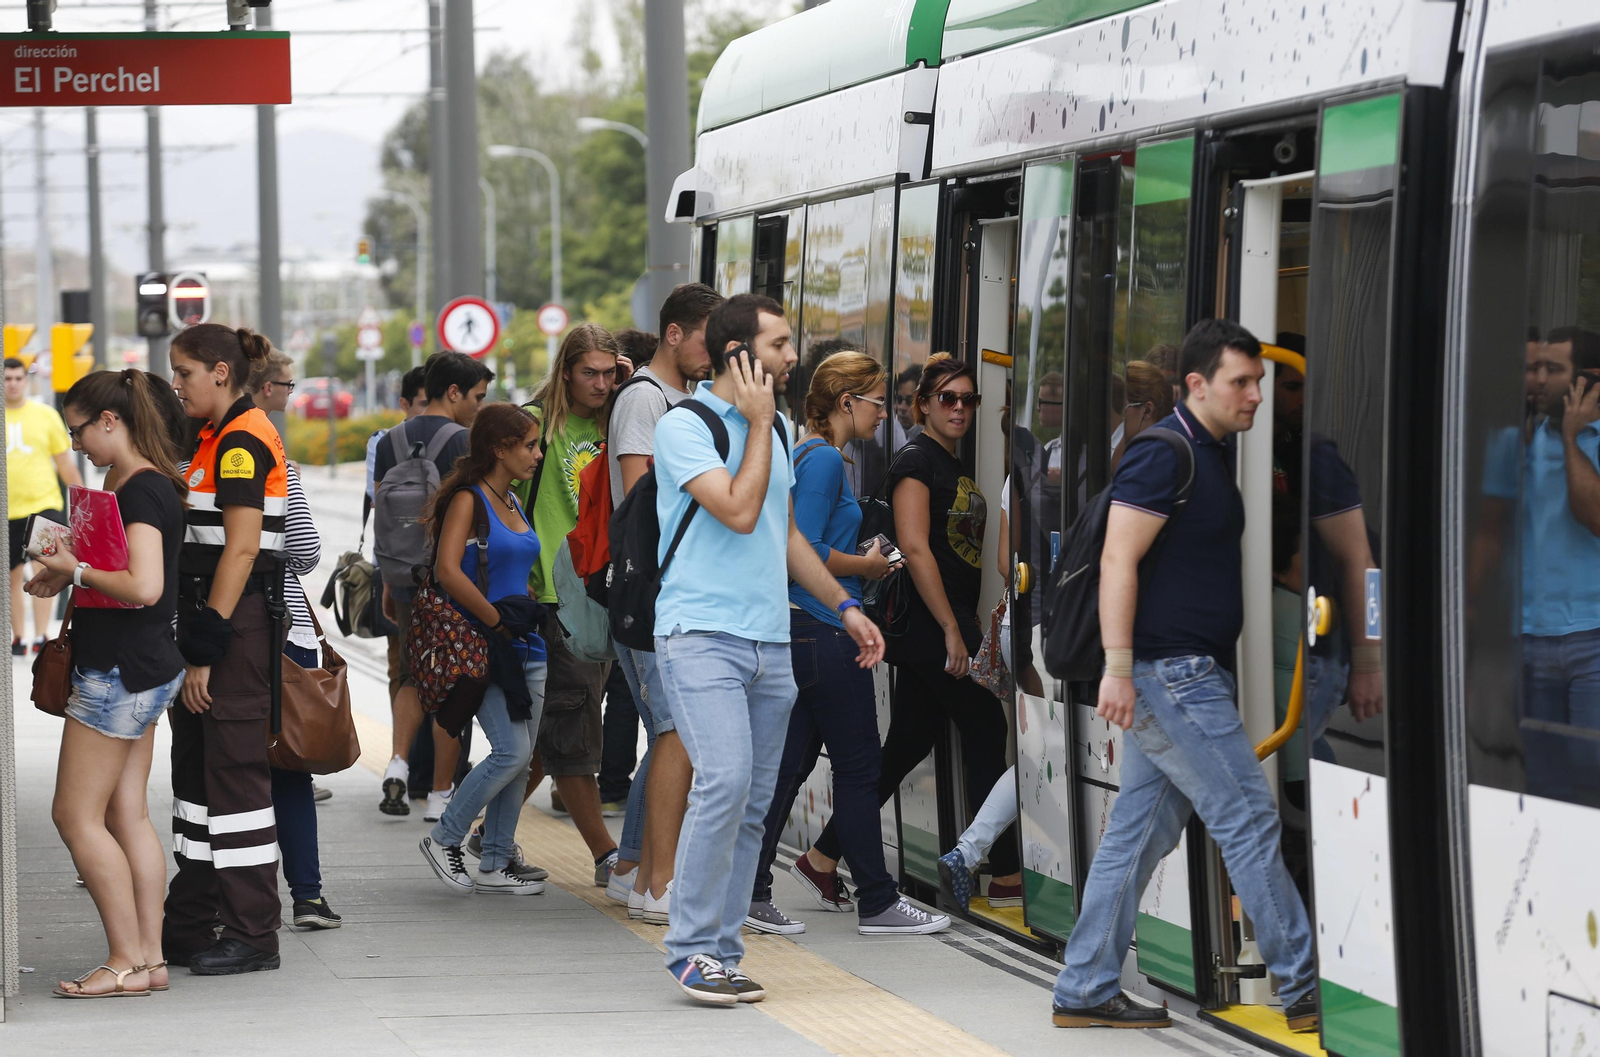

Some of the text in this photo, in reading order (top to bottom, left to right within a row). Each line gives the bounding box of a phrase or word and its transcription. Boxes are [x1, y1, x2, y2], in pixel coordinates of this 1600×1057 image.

[14, 45, 77, 58] dirección
[14, 66, 160, 93] El Perchel
